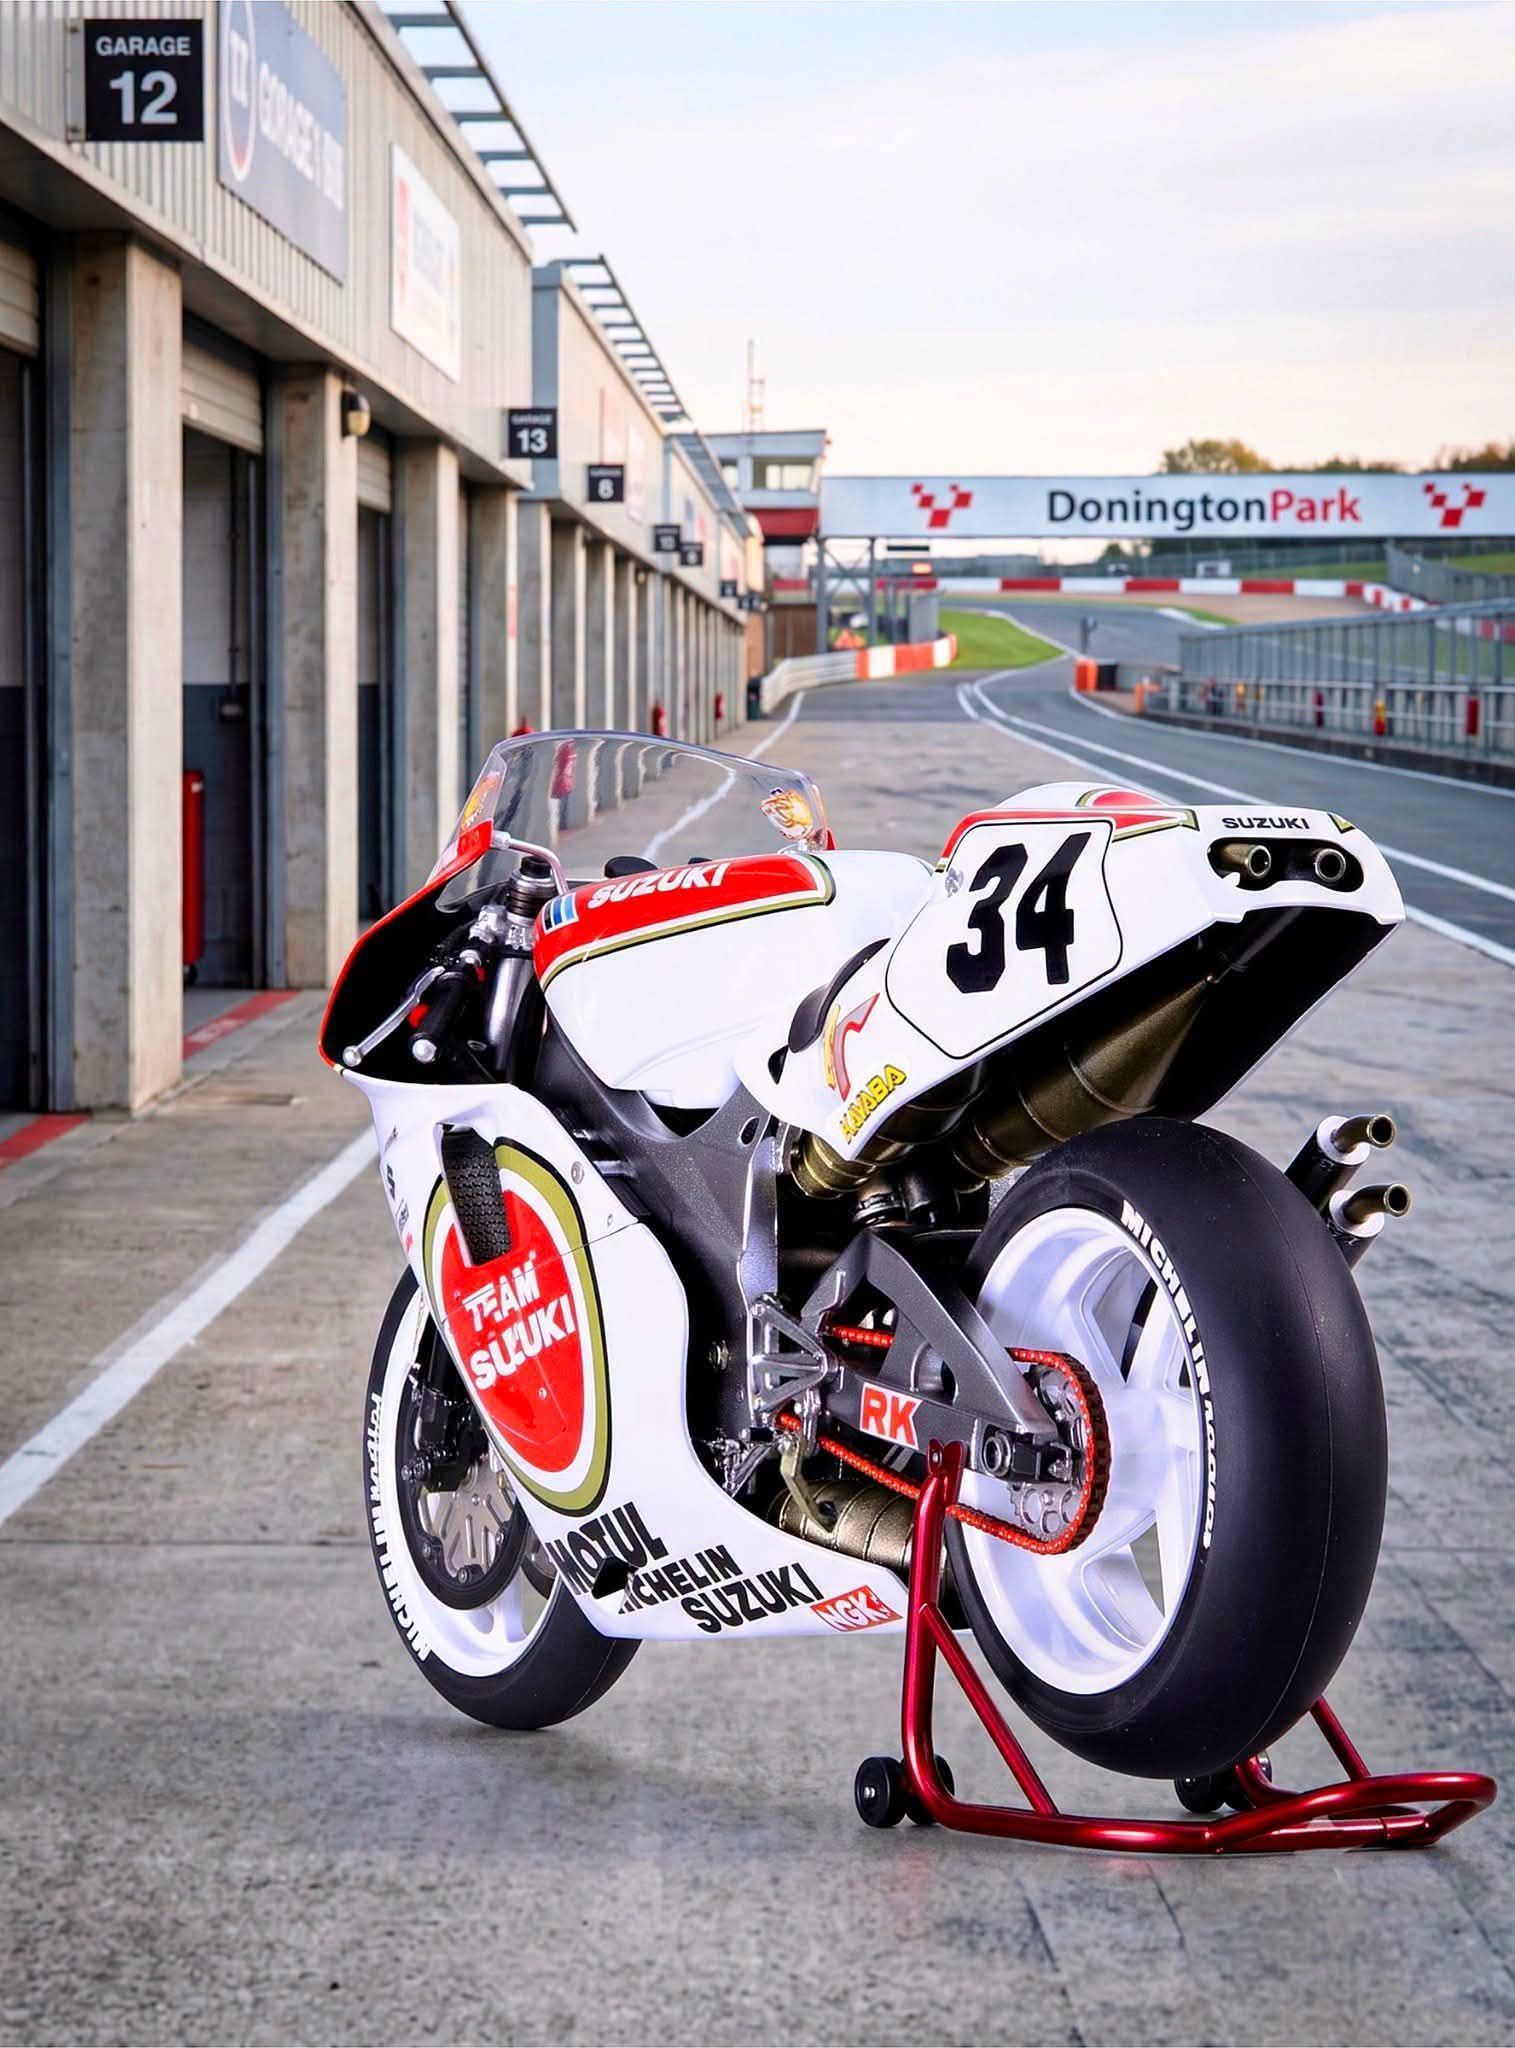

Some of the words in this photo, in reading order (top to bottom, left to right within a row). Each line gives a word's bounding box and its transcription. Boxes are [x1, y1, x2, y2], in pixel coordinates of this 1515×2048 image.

[96, 35, 191, 56] GARAGE
[110, 70, 178, 124] 12
[516, 428, 548, 453] 13
[1048, 487, 1361, 531] DoningtonPark
[1221, 816, 1311, 830] SUZUKI
[587, 863, 730, 909] SUZUKI
[946, 832, 1092, 994] 34
[840, 1064, 907, 1145] KAYABA
[462, 1260, 540, 1332] TEAM
[1121, 1200, 1210, 1396] MICHELIN
[469, 1293, 577, 1391] SUZUKI
[863, 1387, 917, 1446] RK
[544, 1501, 669, 1596] MOTUL
[618, 1544, 743, 1614] ICHELIN
[680, 1561, 825, 1633] SUZUKI
[815, 1590, 889, 1631] NGK
